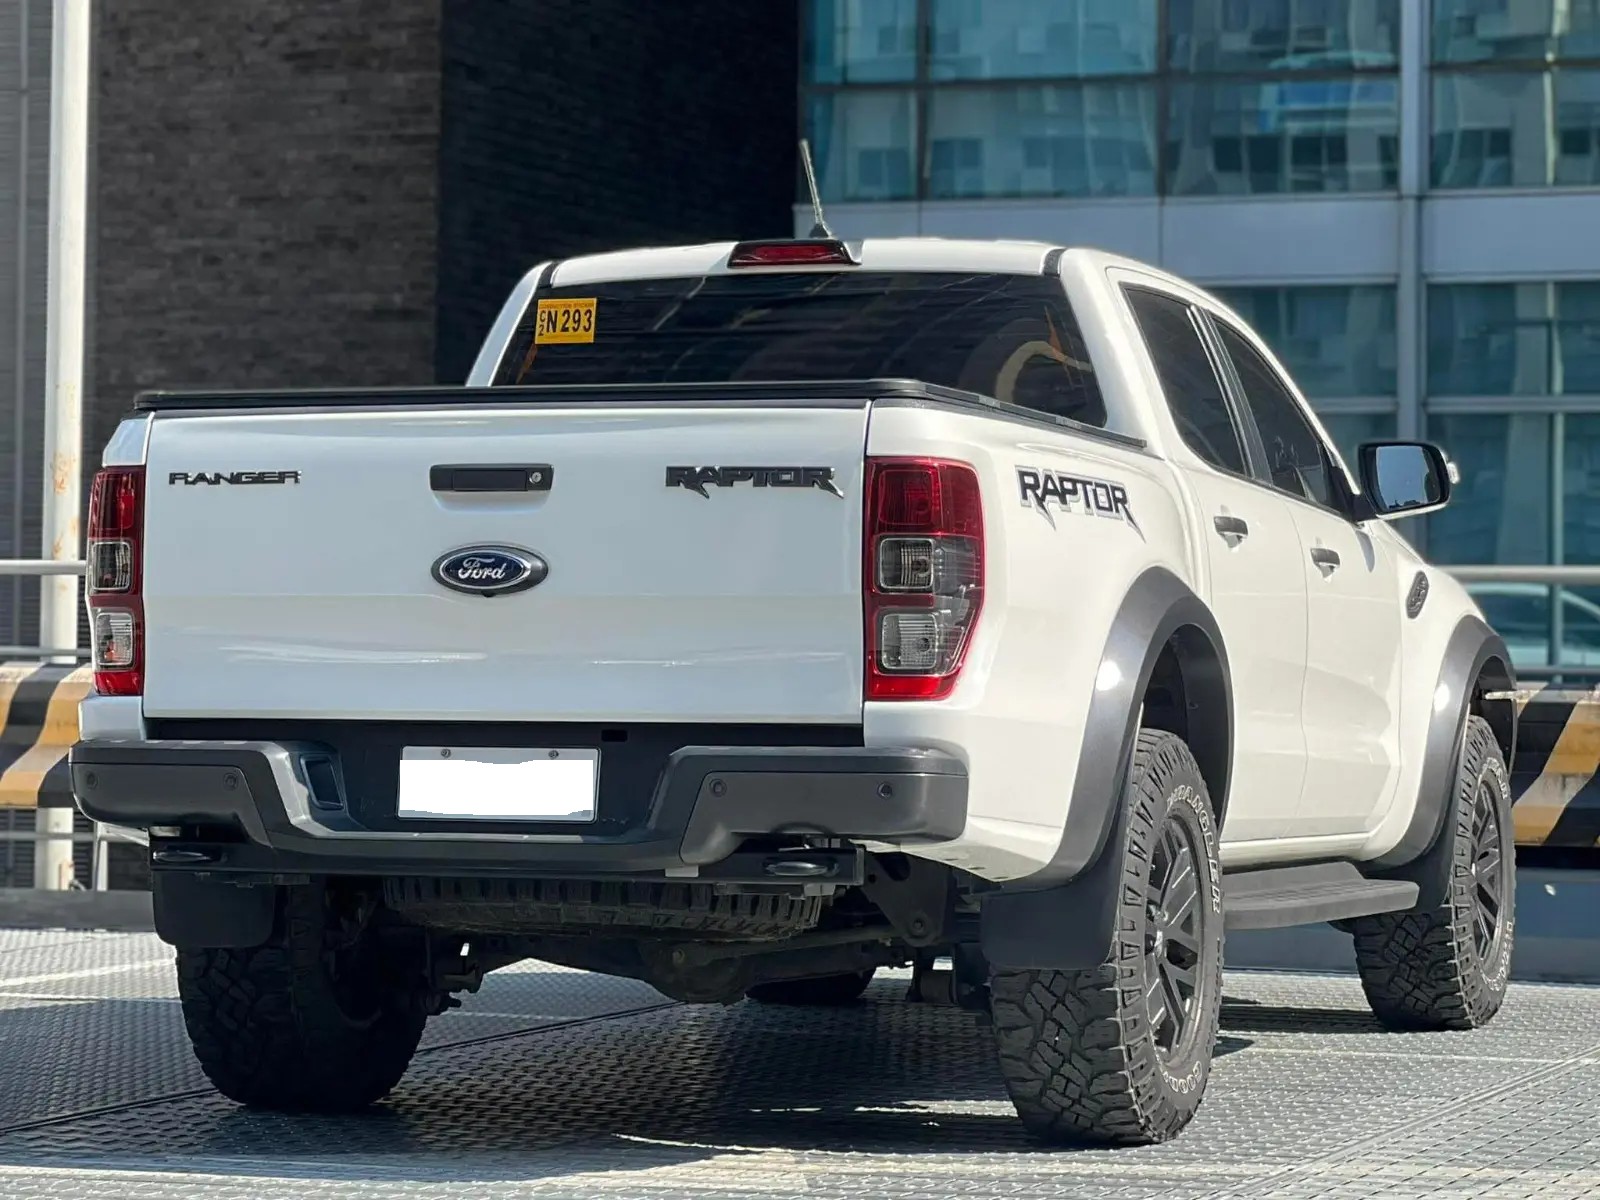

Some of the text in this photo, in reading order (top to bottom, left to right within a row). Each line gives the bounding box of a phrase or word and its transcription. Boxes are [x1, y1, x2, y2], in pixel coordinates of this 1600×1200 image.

[168, 470, 302, 486] RANGER
[665, 465, 845, 499] RAPTOR
[1015, 465, 1147, 544] RAPTOR
[457, 557, 507, 579] Ford
